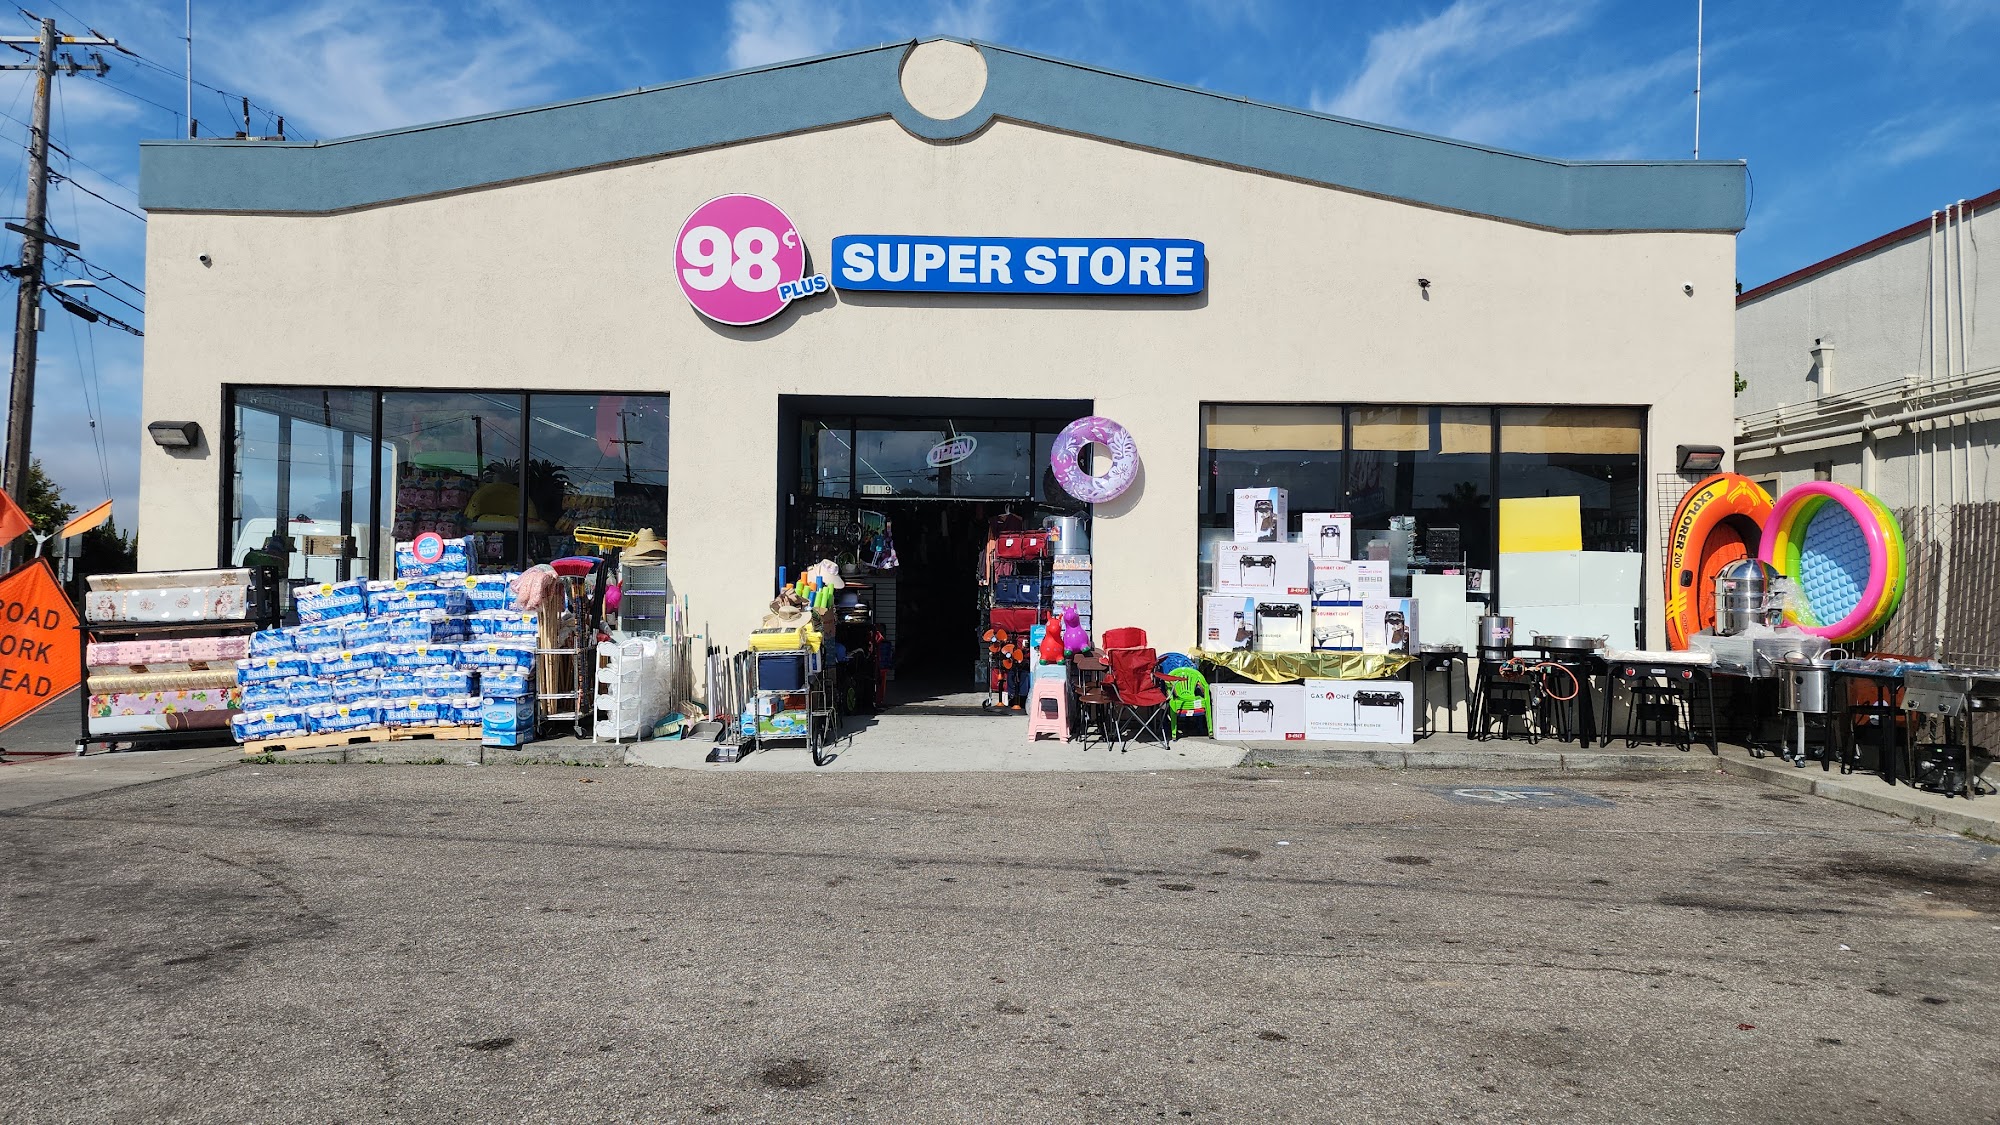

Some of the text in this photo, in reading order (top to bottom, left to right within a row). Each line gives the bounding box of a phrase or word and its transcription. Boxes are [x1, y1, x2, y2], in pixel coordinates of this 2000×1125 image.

[842, 243, 1195, 287] SUPER STORE
[779, 275, 827, 300] PLUS
[930, 438, 971, 464] OPEN
[1673, 490, 1714, 569] EXPLORER 200
